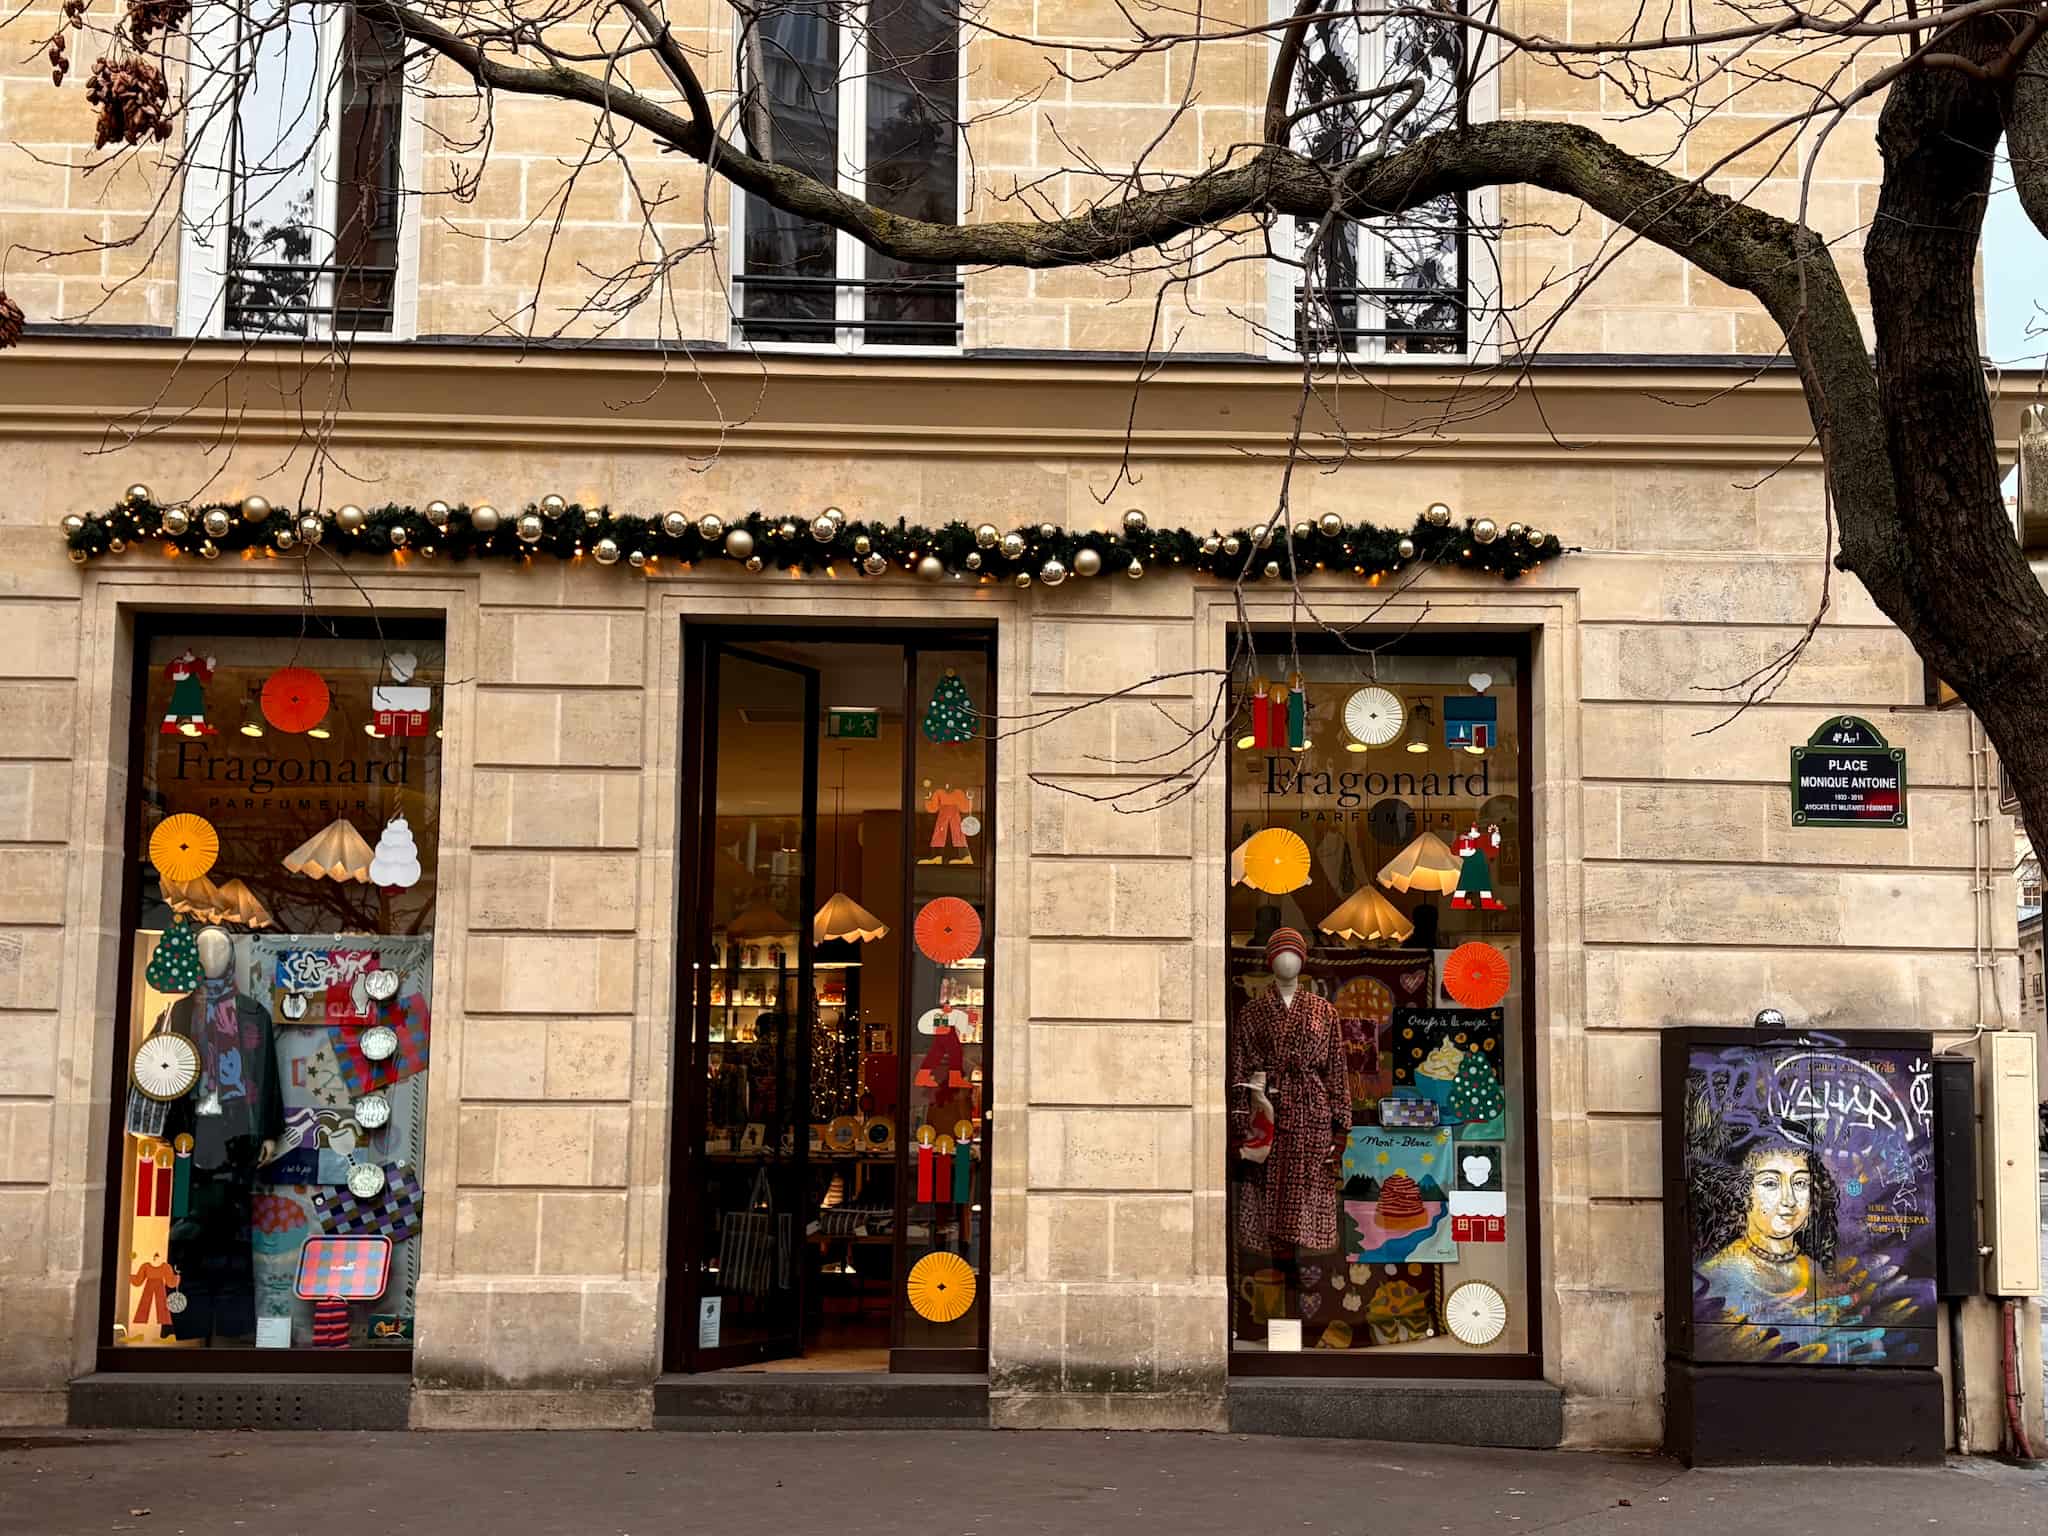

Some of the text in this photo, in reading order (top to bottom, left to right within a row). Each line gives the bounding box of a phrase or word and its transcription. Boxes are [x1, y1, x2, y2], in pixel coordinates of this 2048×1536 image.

[174, 740, 409, 793] Fragonard
[1828, 759, 1868, 771] PLACE
[1263, 755, 1490, 808] Fragonard
[1800, 776, 1897, 789] MONIQUE ANTOINE
[208, 797, 368, 811] PARFUMEUR
[1299, 811, 1452, 824] PARFUMEUR
